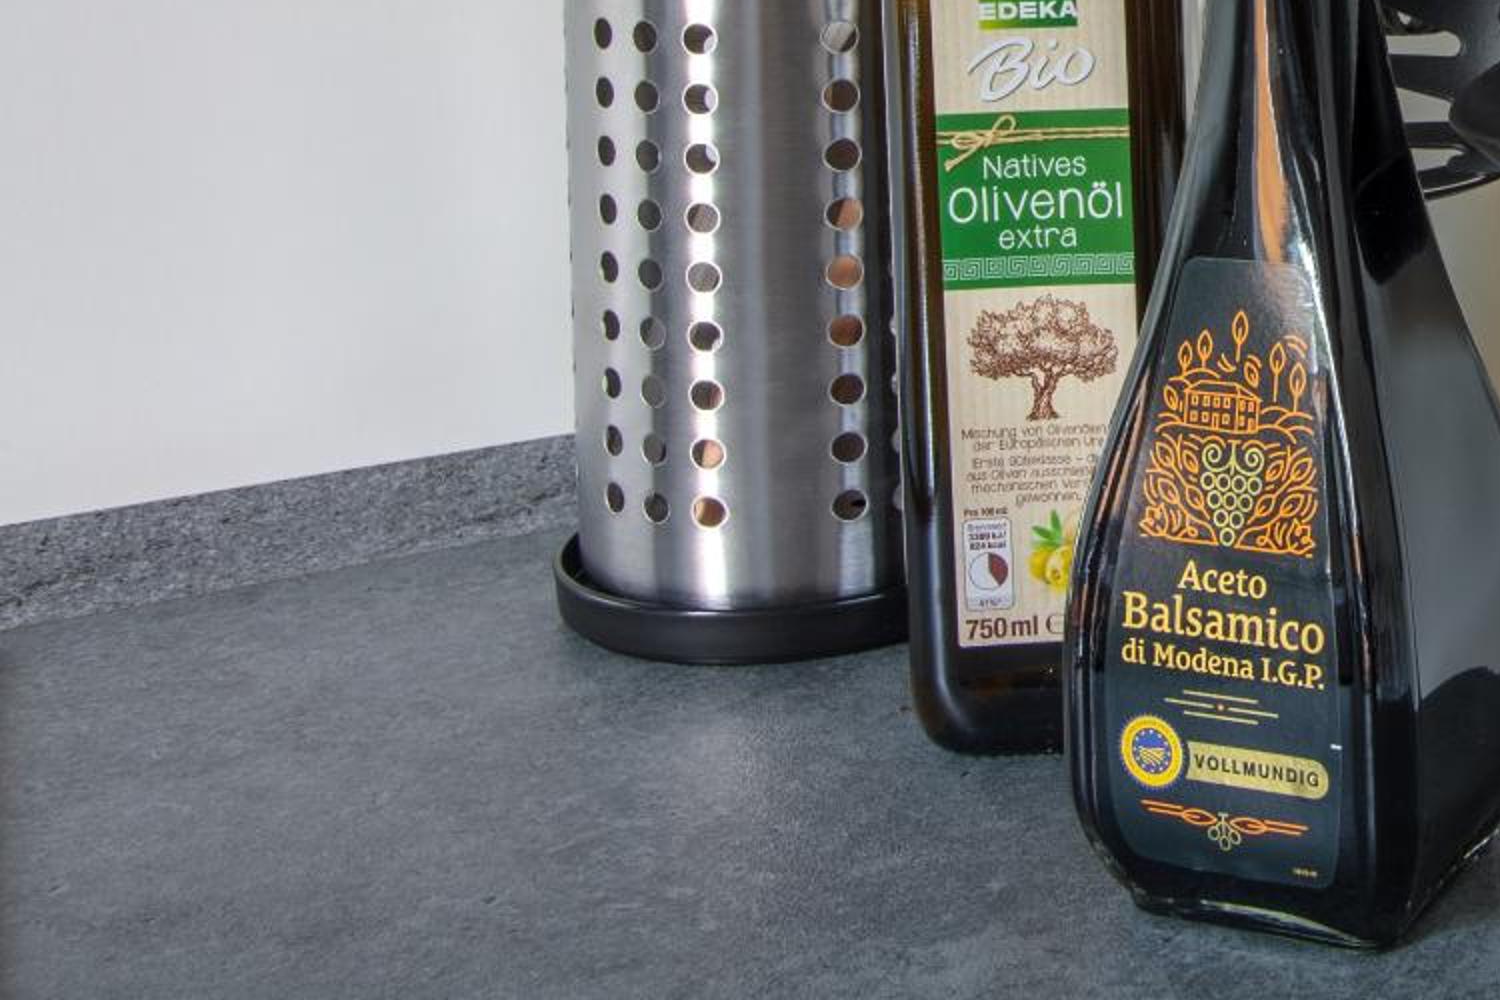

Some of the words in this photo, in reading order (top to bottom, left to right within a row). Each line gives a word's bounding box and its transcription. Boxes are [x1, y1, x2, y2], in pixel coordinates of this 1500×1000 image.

[978, 0, 1078, 20] EDEKA
[967, 39, 1097, 102] Bio
[983, 154, 1087, 179] Natives
[949, 182, 1124, 224] Olivenöl
[998, 226, 1078, 250] extra
[1021, 424, 1043, 437] von
[1178, 560, 1268, 599] Aceto
[965, 617, 1007, 641] 750
[1011, 615, 1039, 636] ml
[1122, 591, 1326, 654] Balsamico
[1121, 638, 1146, 664] di
[1152, 643, 1255, 680] Modena
[1262, 657, 1326, 690] I.G.P.
[1193, 753, 1320, 788] VOLLMUNDIG
